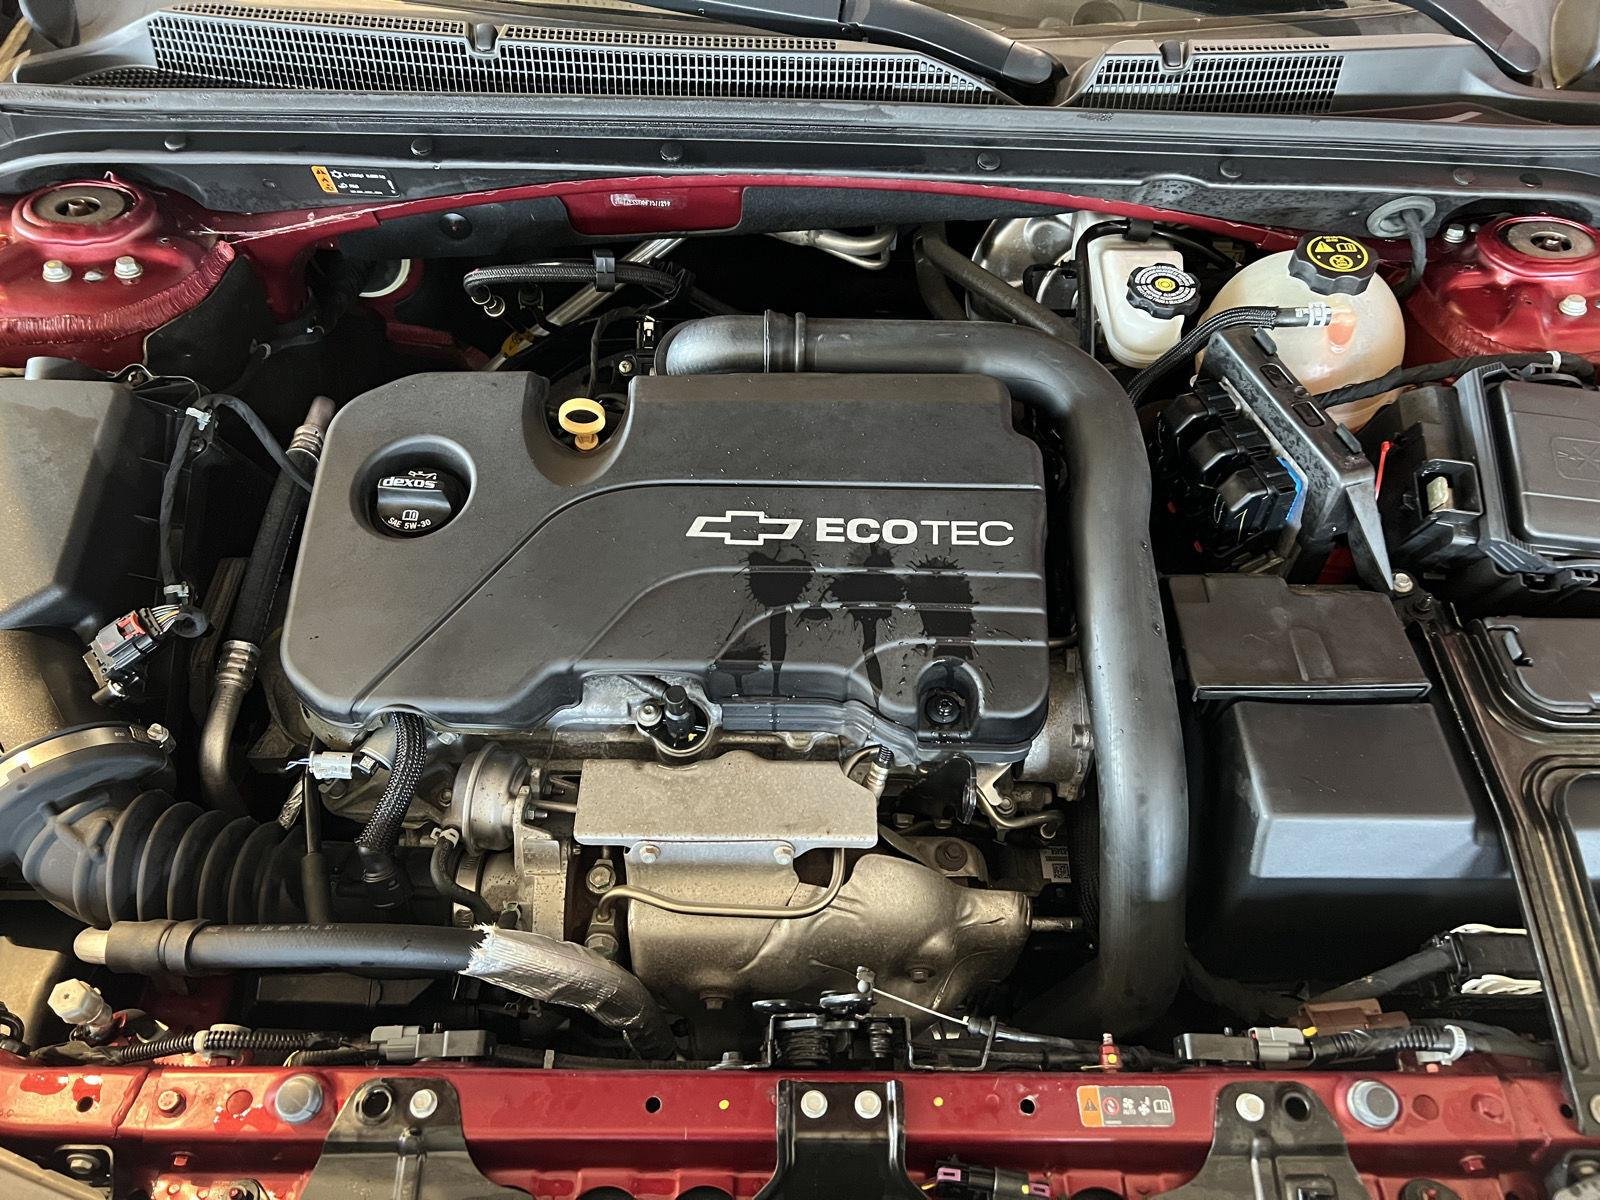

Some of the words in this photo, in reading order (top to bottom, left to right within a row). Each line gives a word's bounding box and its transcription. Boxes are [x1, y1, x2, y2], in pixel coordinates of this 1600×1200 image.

[382, 476, 436, 489] dexos
[387, 517, 402, 528] SAE
[403, 518, 432, 530] 5W-30
[816, 517, 1014, 546] ECOTEC
